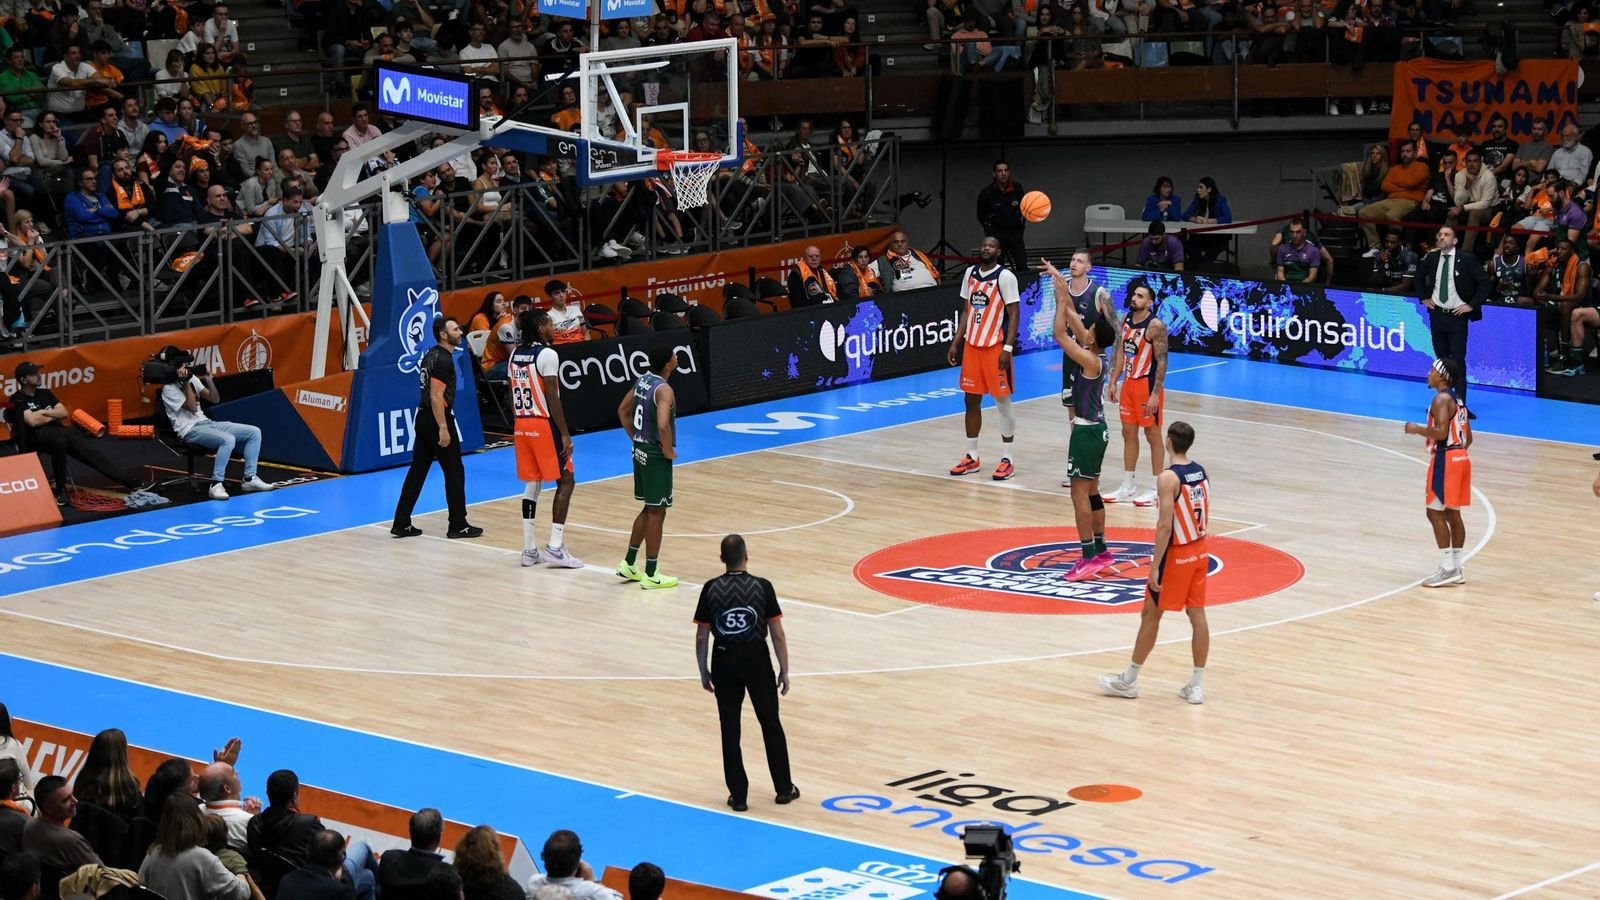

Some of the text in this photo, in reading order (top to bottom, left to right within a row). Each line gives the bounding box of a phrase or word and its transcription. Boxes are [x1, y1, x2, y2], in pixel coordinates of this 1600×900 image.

[417, 87, 464, 109] Movistar
[1412, 77, 1576, 105] TSUNAMI
[1229, 309, 1405, 352] quirónsalud
[559, 344, 697, 390] endea
[302, 394, 331, 406] Aluman
[513, 387, 534, 410] 33
[633, 404, 644, 430] 6
[12, 505, 320, 565] endesa
[725, 613, 747, 628] 53
[885, 769, 1076, 816] liga
